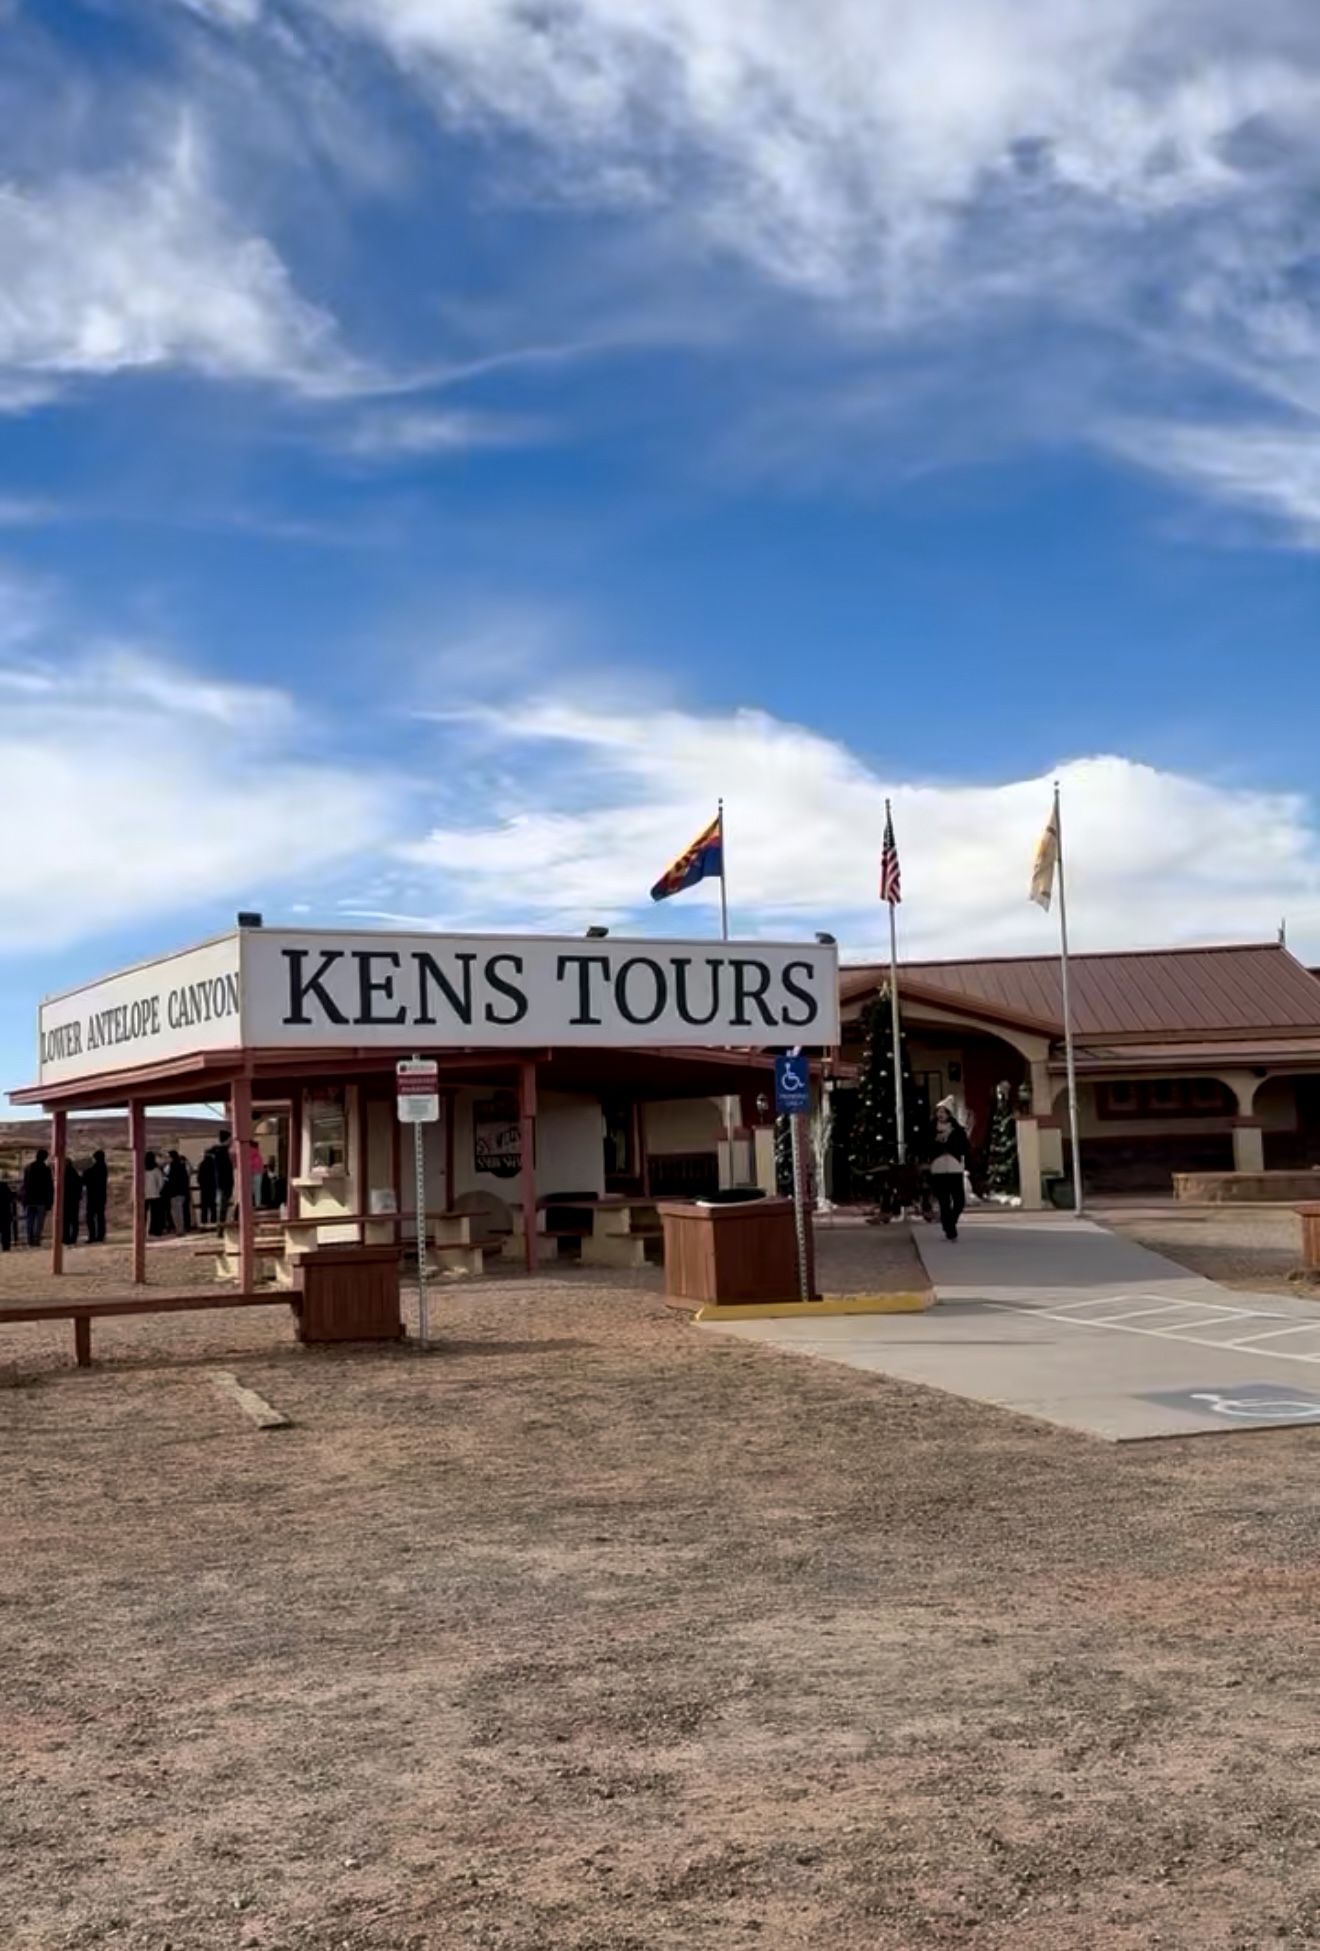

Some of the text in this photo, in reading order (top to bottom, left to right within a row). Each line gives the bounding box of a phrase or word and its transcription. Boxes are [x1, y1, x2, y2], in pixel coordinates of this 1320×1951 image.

[41, 972, 239, 1064] LOWER ANTELOPE CANYON
[282, 949, 819, 1026] KENS TOURS
